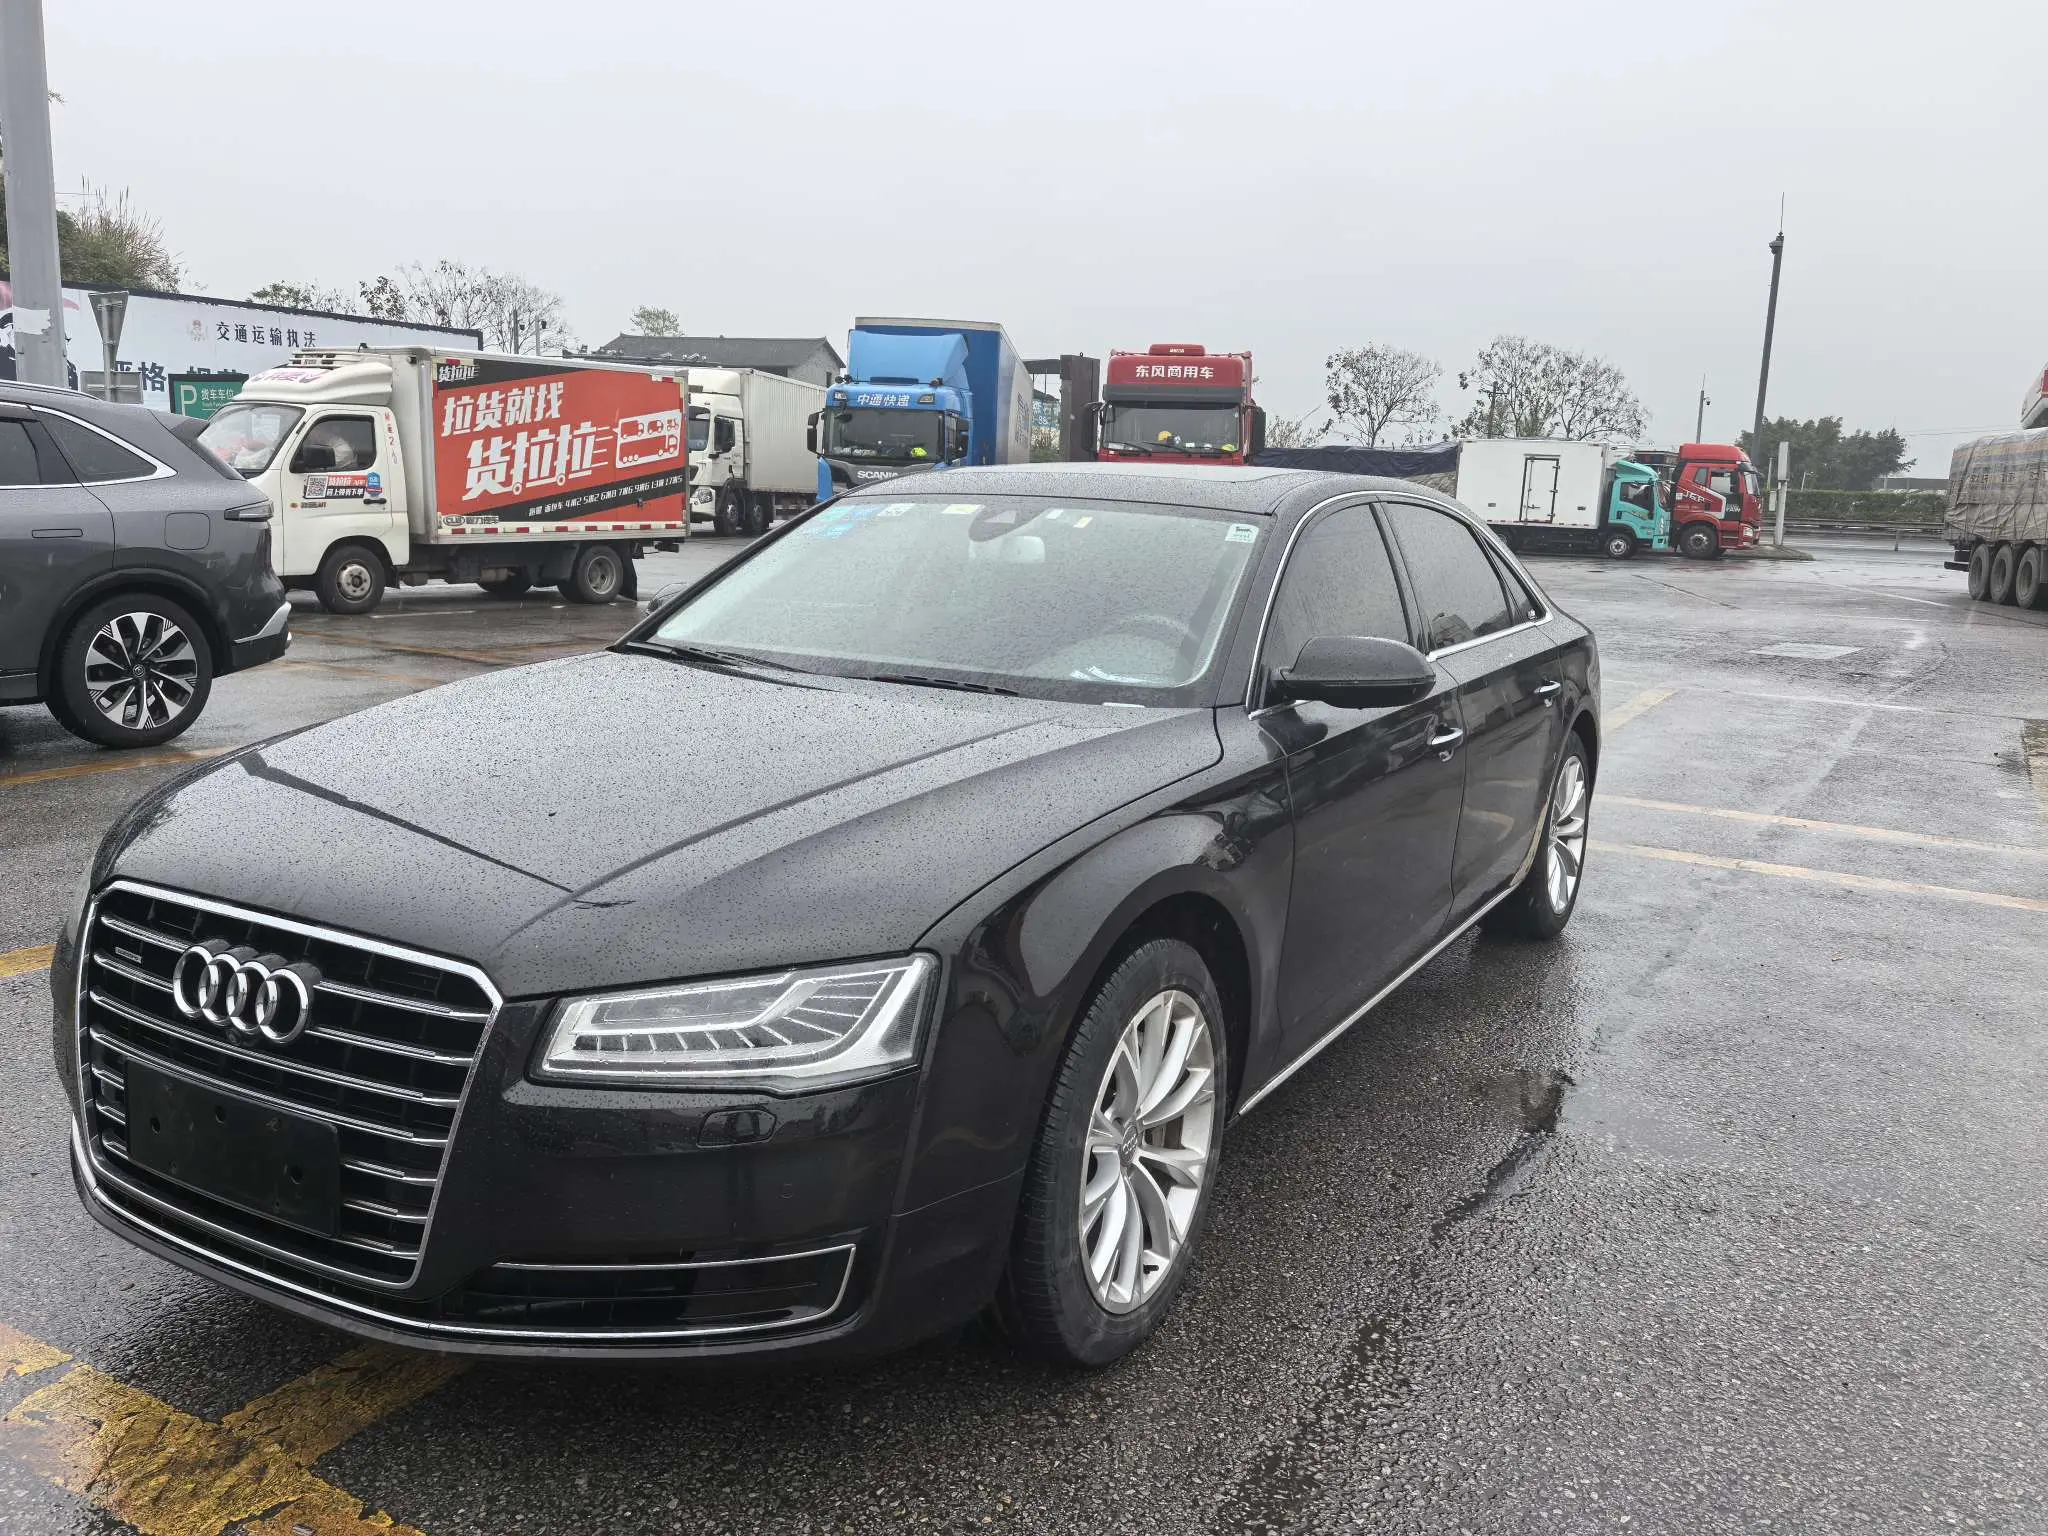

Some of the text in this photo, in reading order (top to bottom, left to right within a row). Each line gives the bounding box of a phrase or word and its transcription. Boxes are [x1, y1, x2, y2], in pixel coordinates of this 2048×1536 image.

[216, 321, 316, 347] 交通运输执法
[1136, 365, 1214, 379] 东风商用车
[201, 388, 234, 400] 货车车位
[857, 393, 910, 406] 中通快递
[441, 382, 564, 437] 拉货就找
[462, 421, 599, 501] 货拉拉
